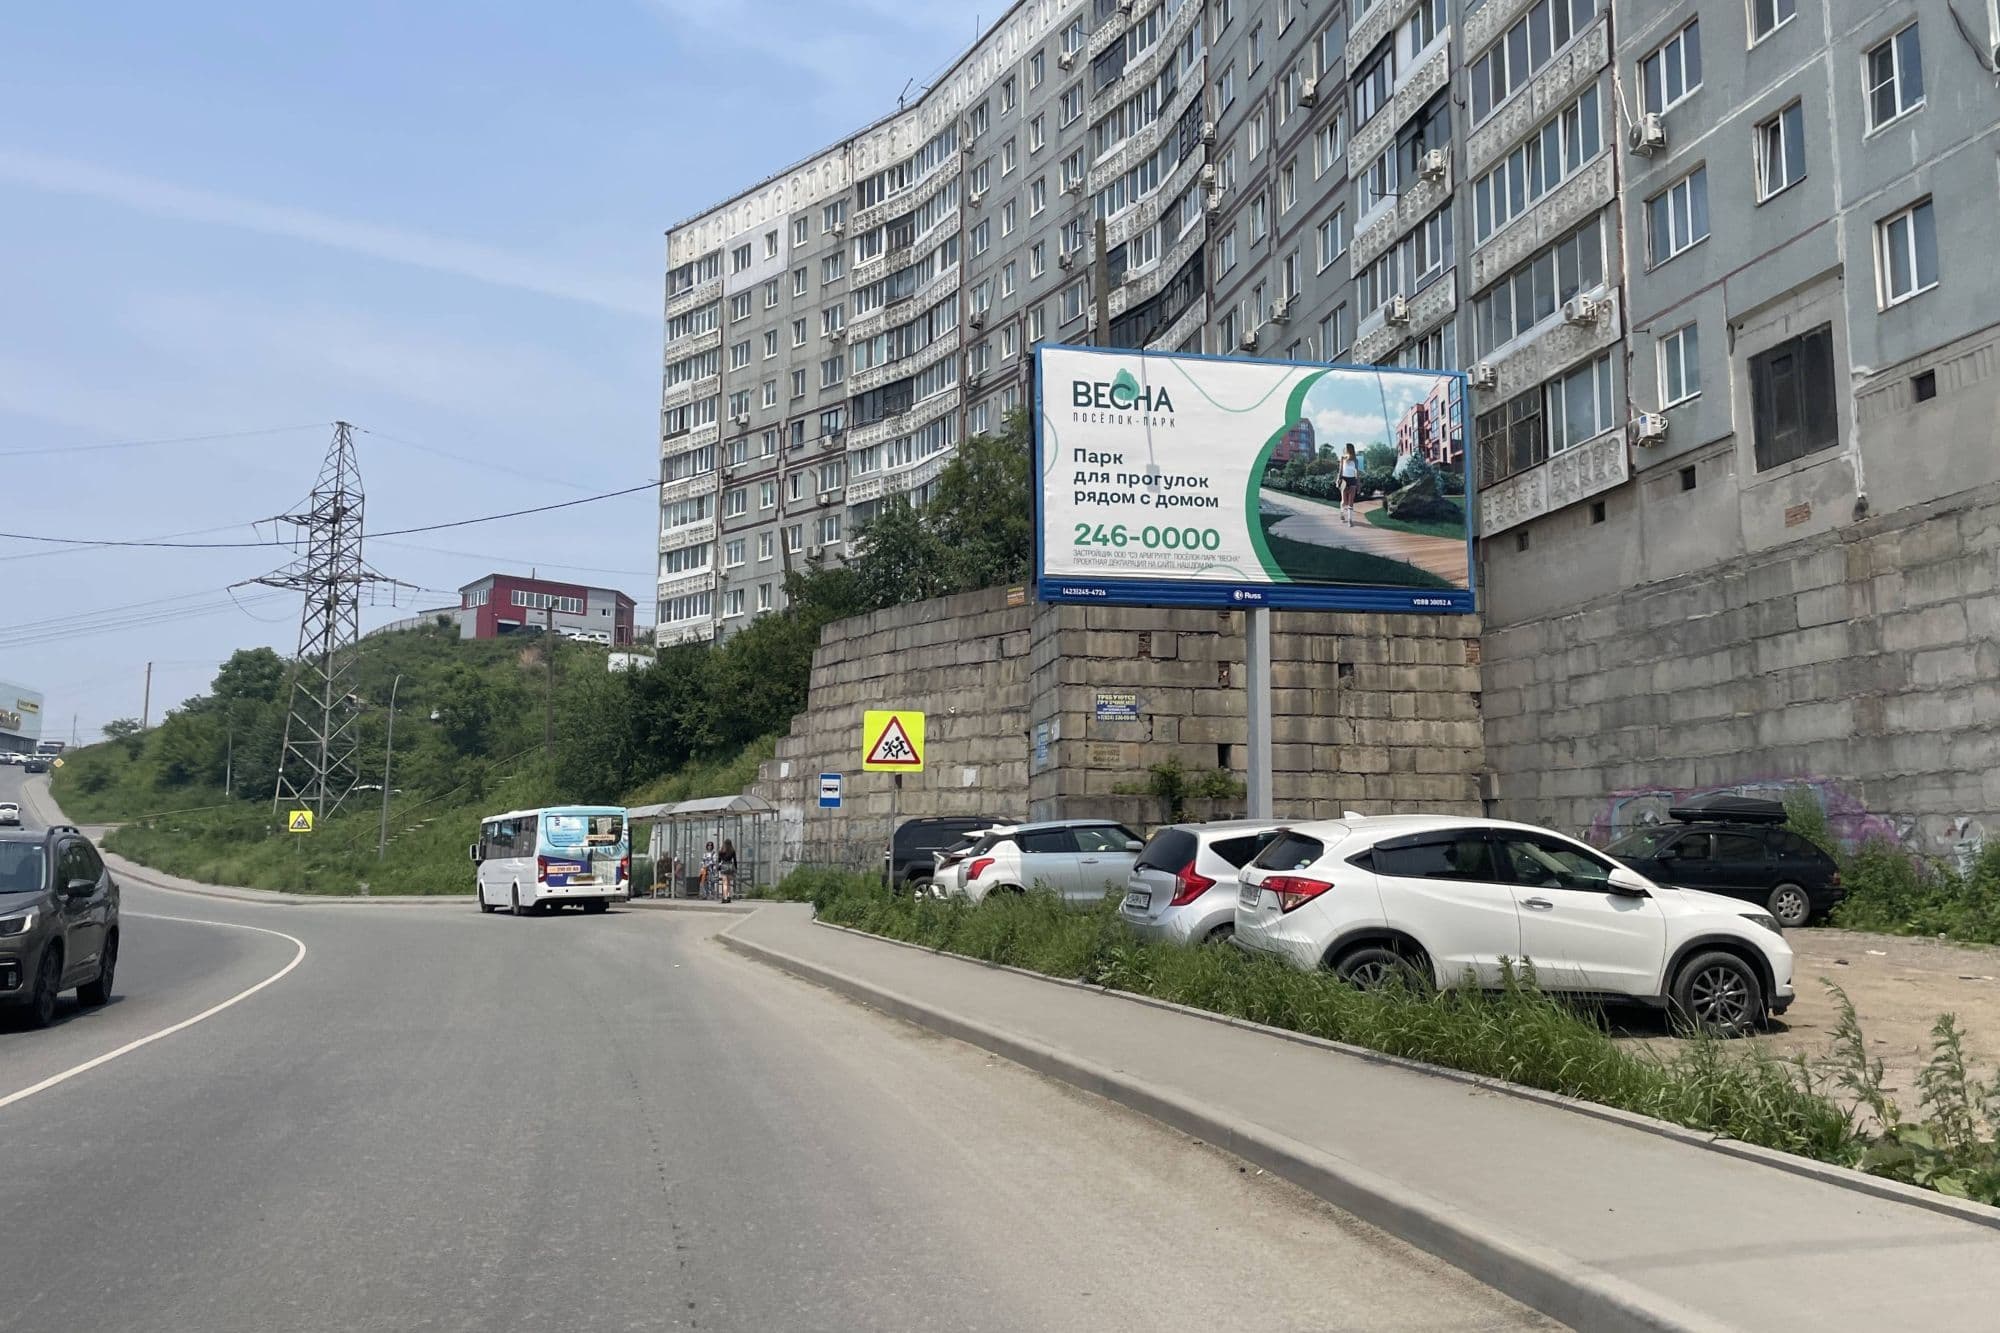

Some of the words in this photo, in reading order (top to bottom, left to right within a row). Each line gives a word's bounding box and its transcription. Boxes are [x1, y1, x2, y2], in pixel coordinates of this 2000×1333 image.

[1073, 380, 1174, 413] ВЕСНА
[1073, 412, 1175, 428] ПОСЁЛОК-ПАРК
[1074, 448, 1123, 467] Парк
[1074, 471, 1110, 485] для
[1117, 473, 1209, 490] прогулок
[1074, 490, 1135, 506] рядом
[1140, 494, 1151, 505] с
[1155, 495, 1219, 508] домом
[1074, 523, 1220, 550] 246-0000
[1244, 591, 1262, 600] Russ
